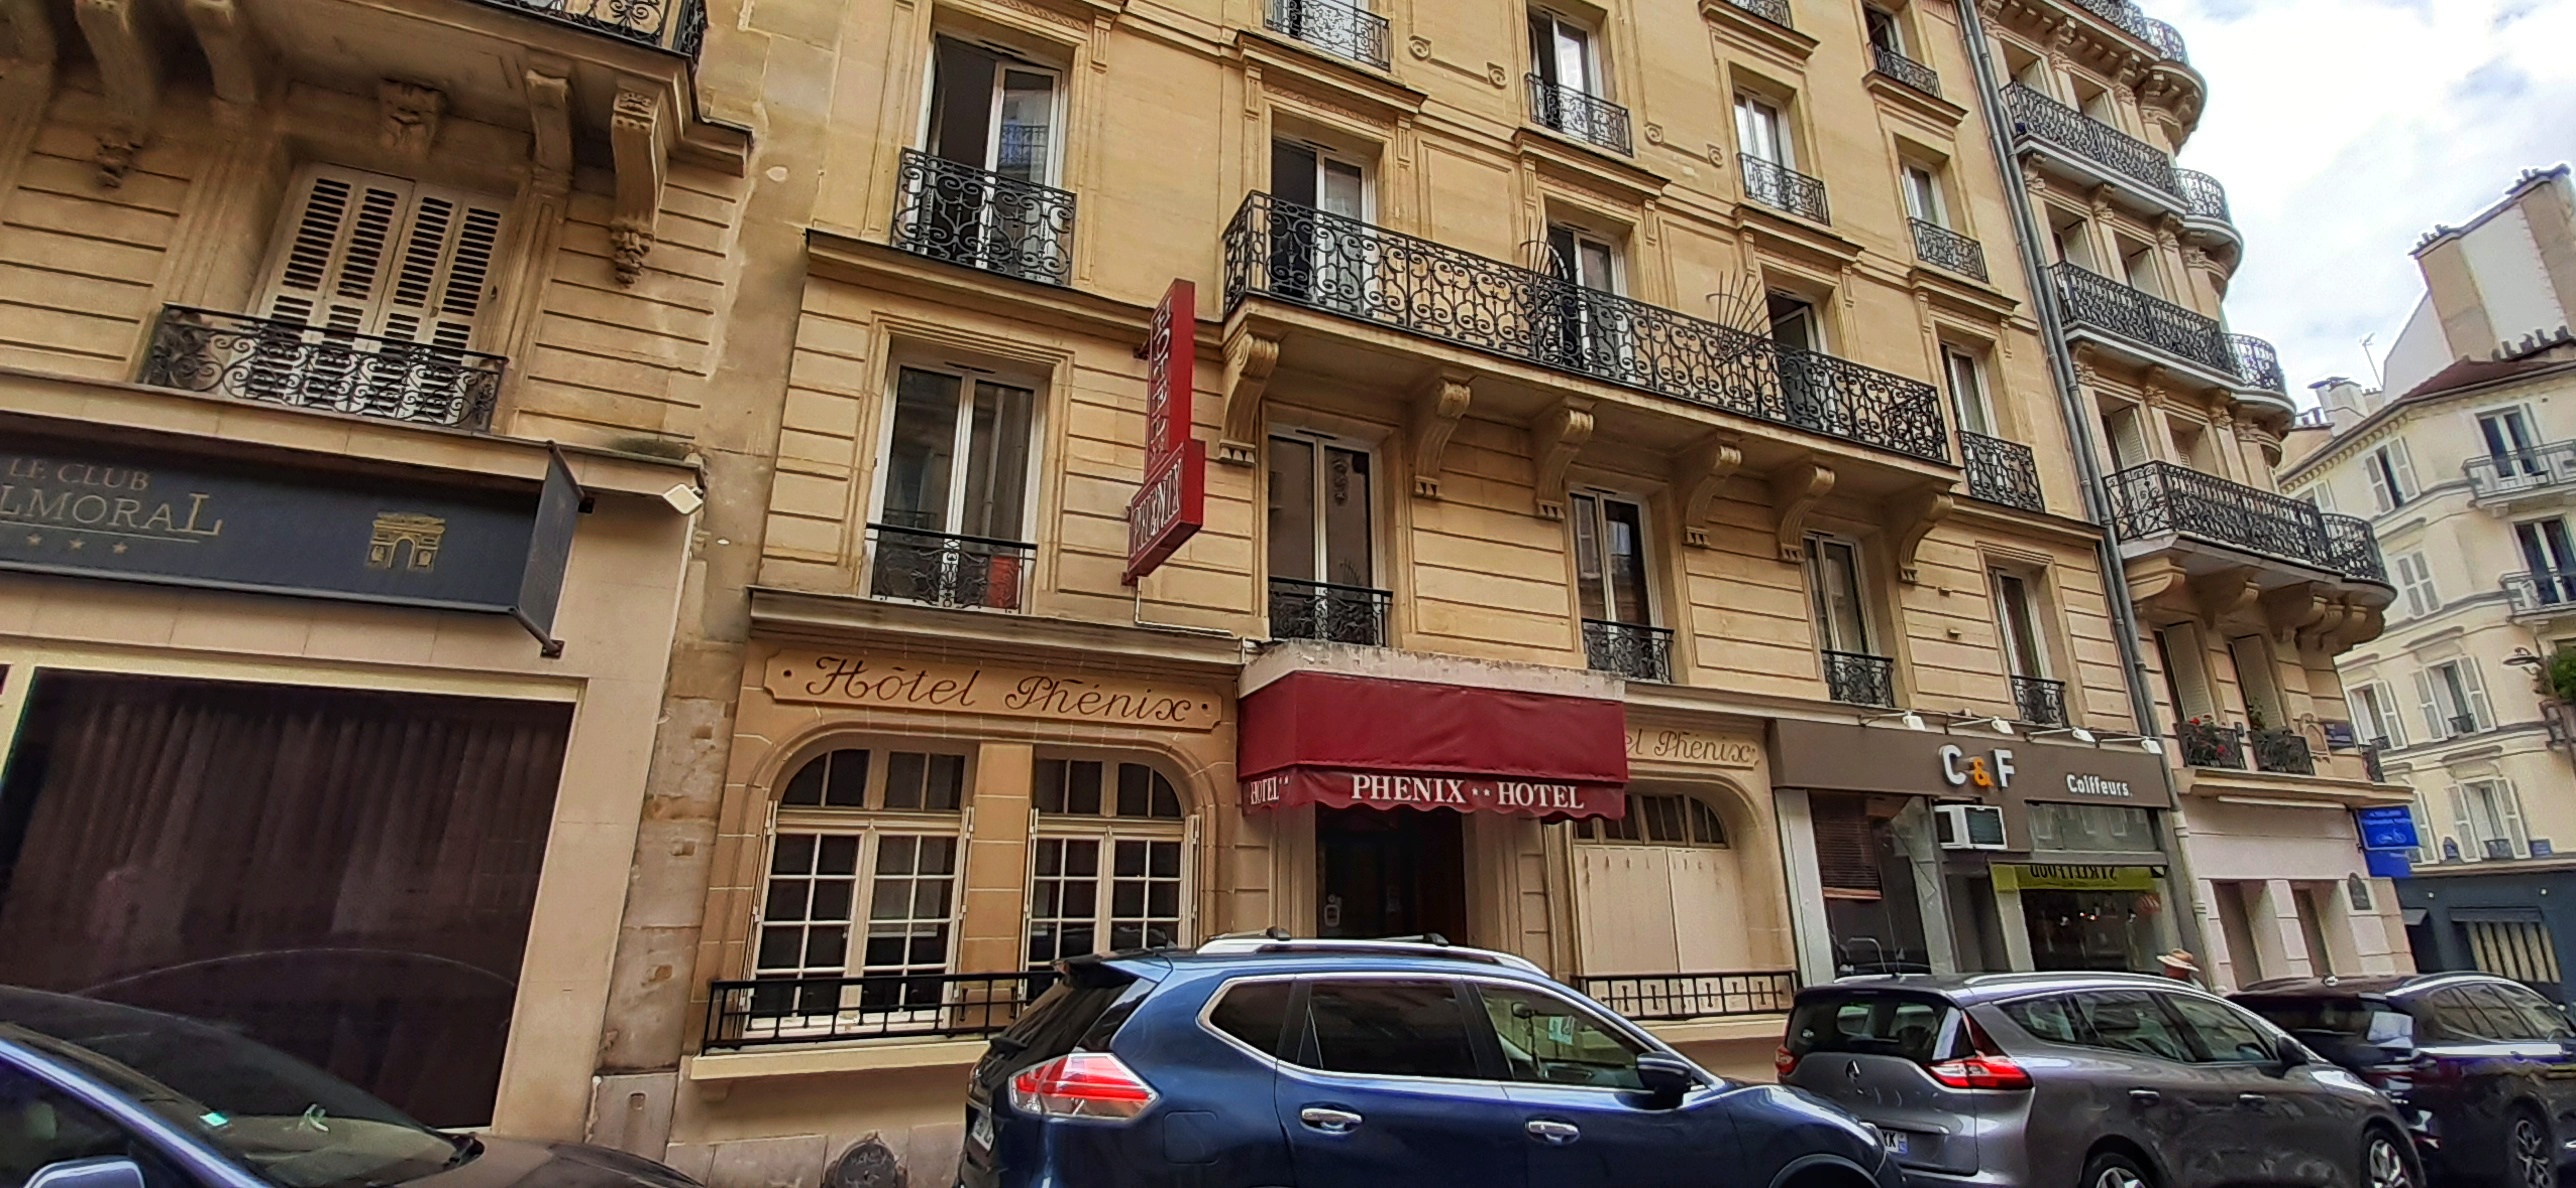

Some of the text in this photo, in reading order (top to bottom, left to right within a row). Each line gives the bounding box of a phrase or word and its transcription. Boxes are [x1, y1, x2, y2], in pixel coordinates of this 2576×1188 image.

[1151, 297, 1172, 445] HOTEL
[9, 457, 150, 491] LE CLUB
[1130, 457, 1182, 557] PHENIX
[805, 655, 1192, 722] Hôtel Phénix
[1938, 744, 1967, 787] C
[1993, 749, 2016, 788] F
[1250, 776, 1279, 805] HOTEL
[1350, 774, 1585, 809] PHENIX HOTEL
